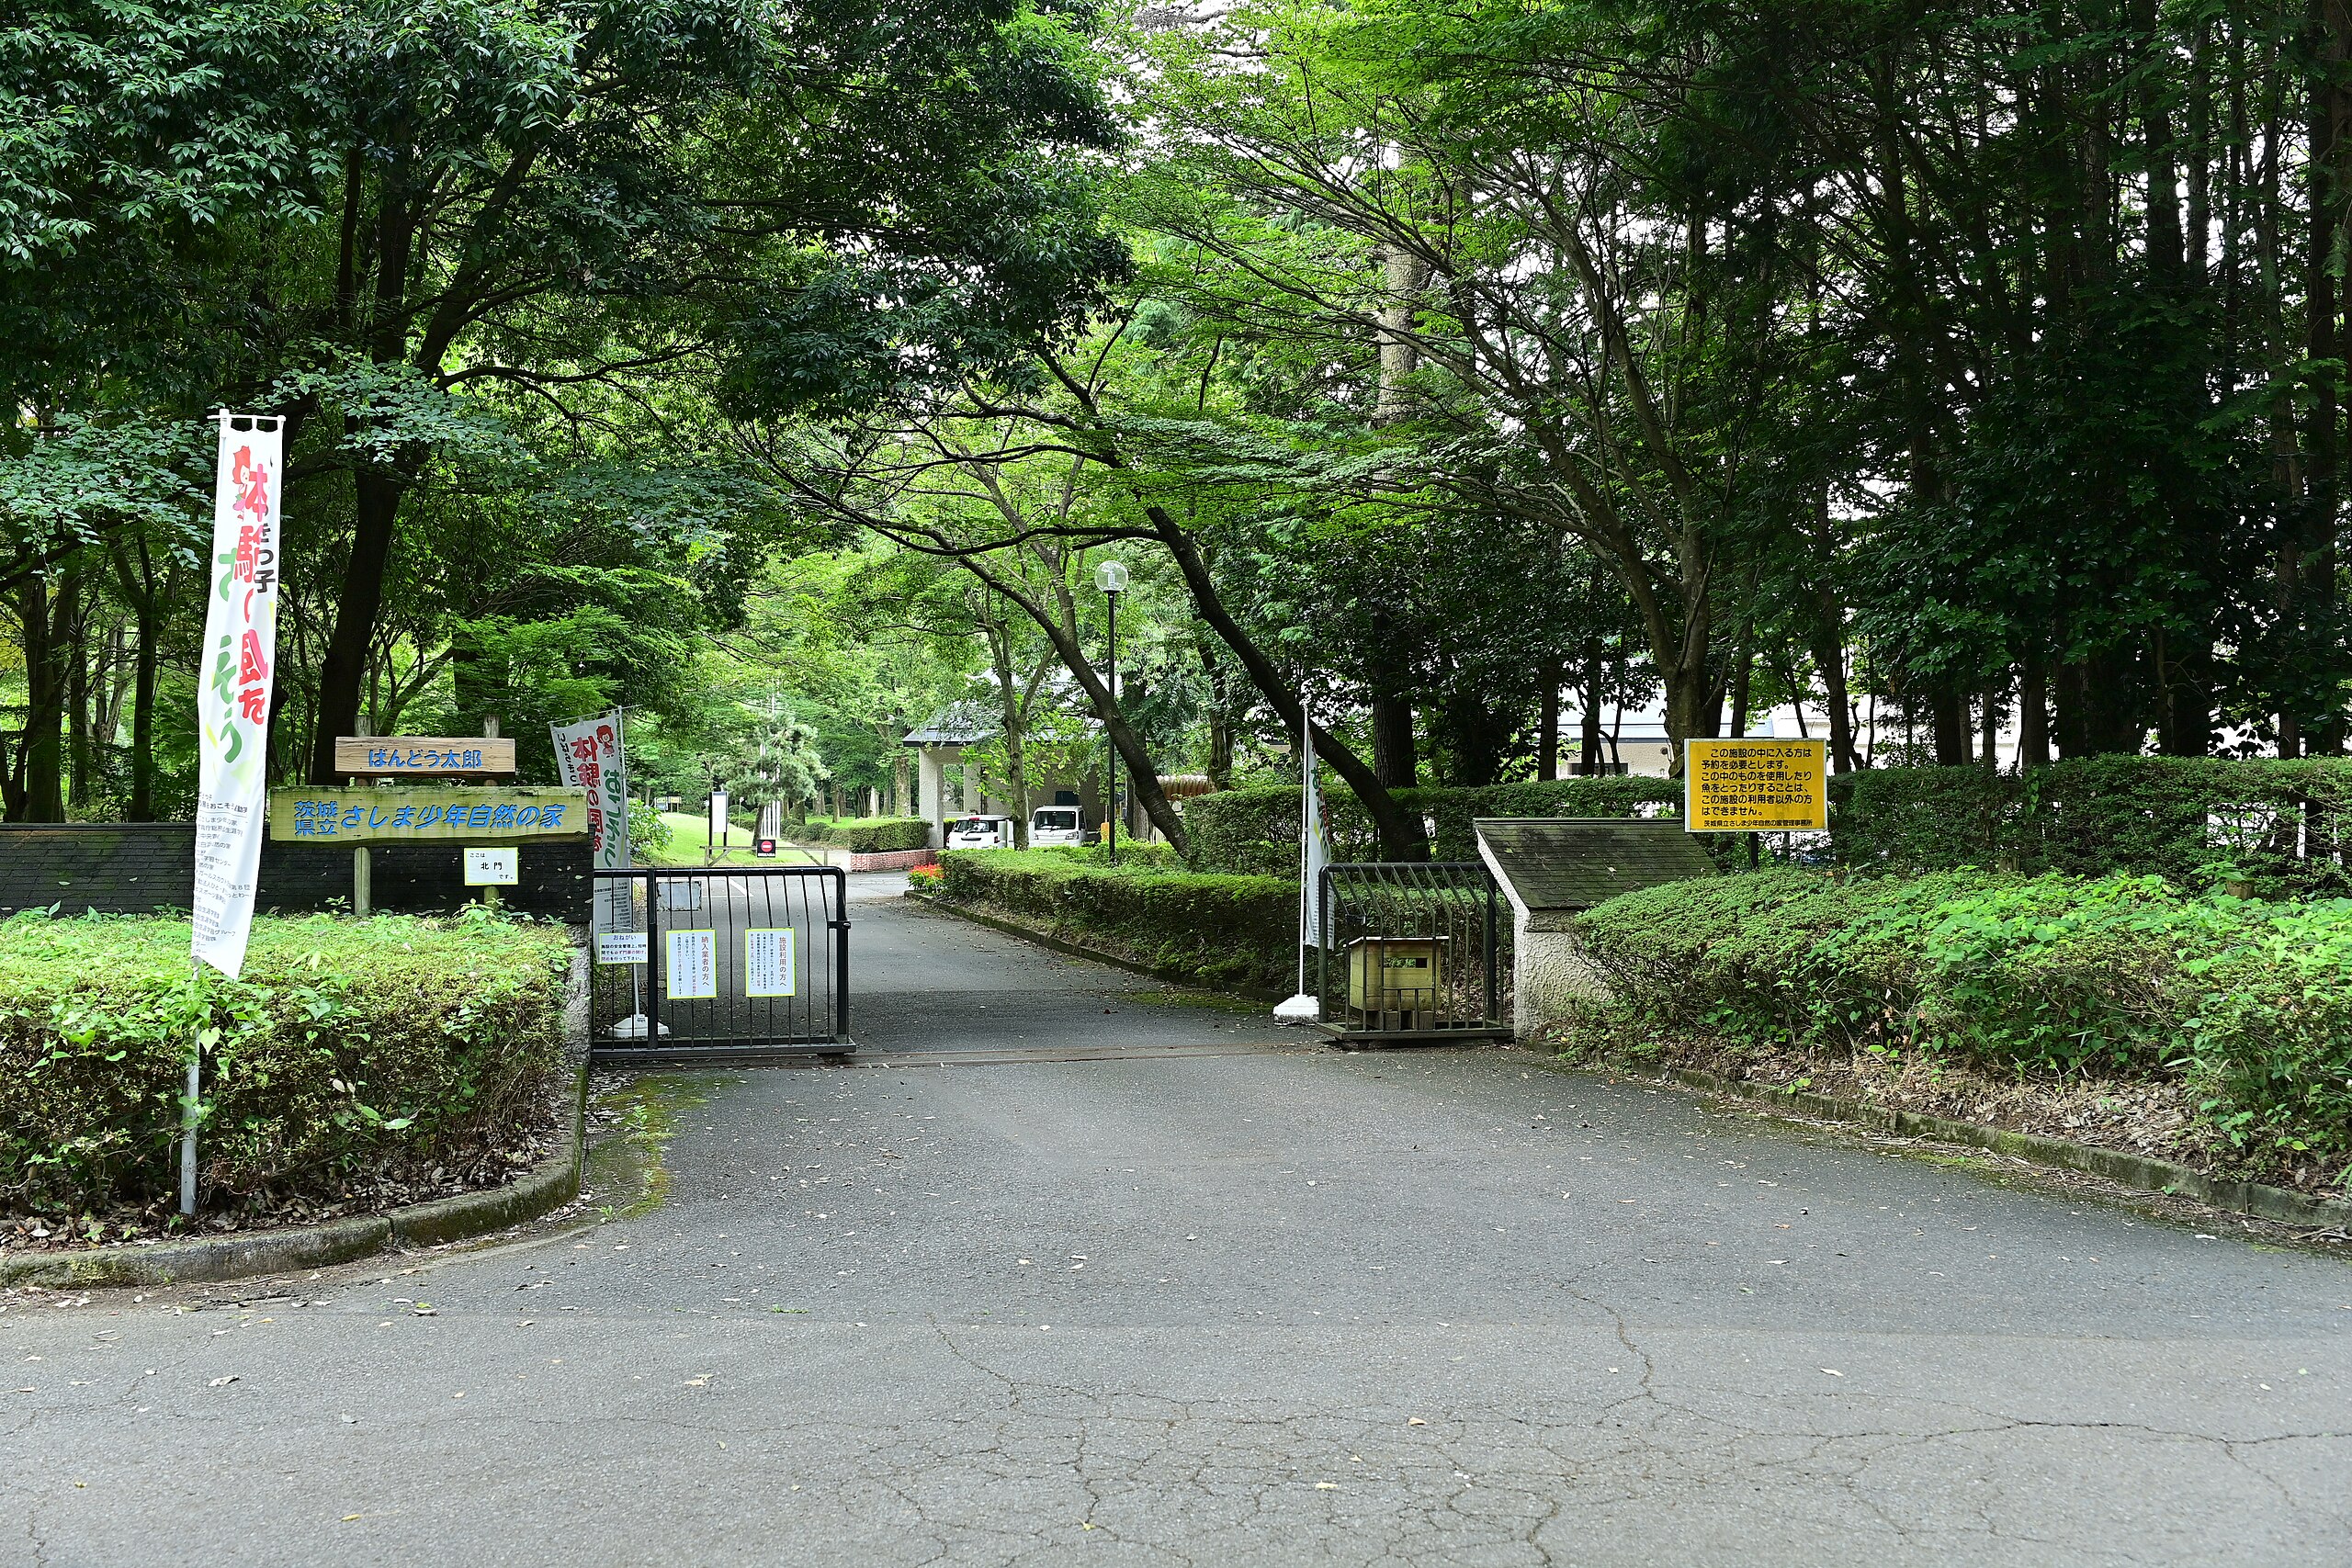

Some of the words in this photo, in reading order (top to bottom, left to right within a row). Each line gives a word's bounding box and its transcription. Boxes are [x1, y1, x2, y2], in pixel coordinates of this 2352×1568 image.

[368, 749, 482, 769] ばんどう太郎
[1710, 748, 1812, 759] この施設の中に入る方は
[1702, 760, 1789, 770] 予約を必要とします。
[1701, 772, 1812, 782] この中のものを使用したり
[1702, 783, 1809, 794] 魚をとったりすることは、
[1702, 795, 1813, 805] この施設の利用者以外の方
[294, 800, 338, 818] 茨城
[1702, 807, 1763, 817] はできません。
[341, 803, 567, 829] さしま少年自然の家
[294, 819, 338, 836] 県立
[1703, 819, 1813, 828] 茨城県立さしま少年自然の家管理事務所
[481, 862, 503, 871] 北門
[701, 935, 710, 987] 納入業者の方へ
[778, 936, 787, 987] 施設利用の方へ
